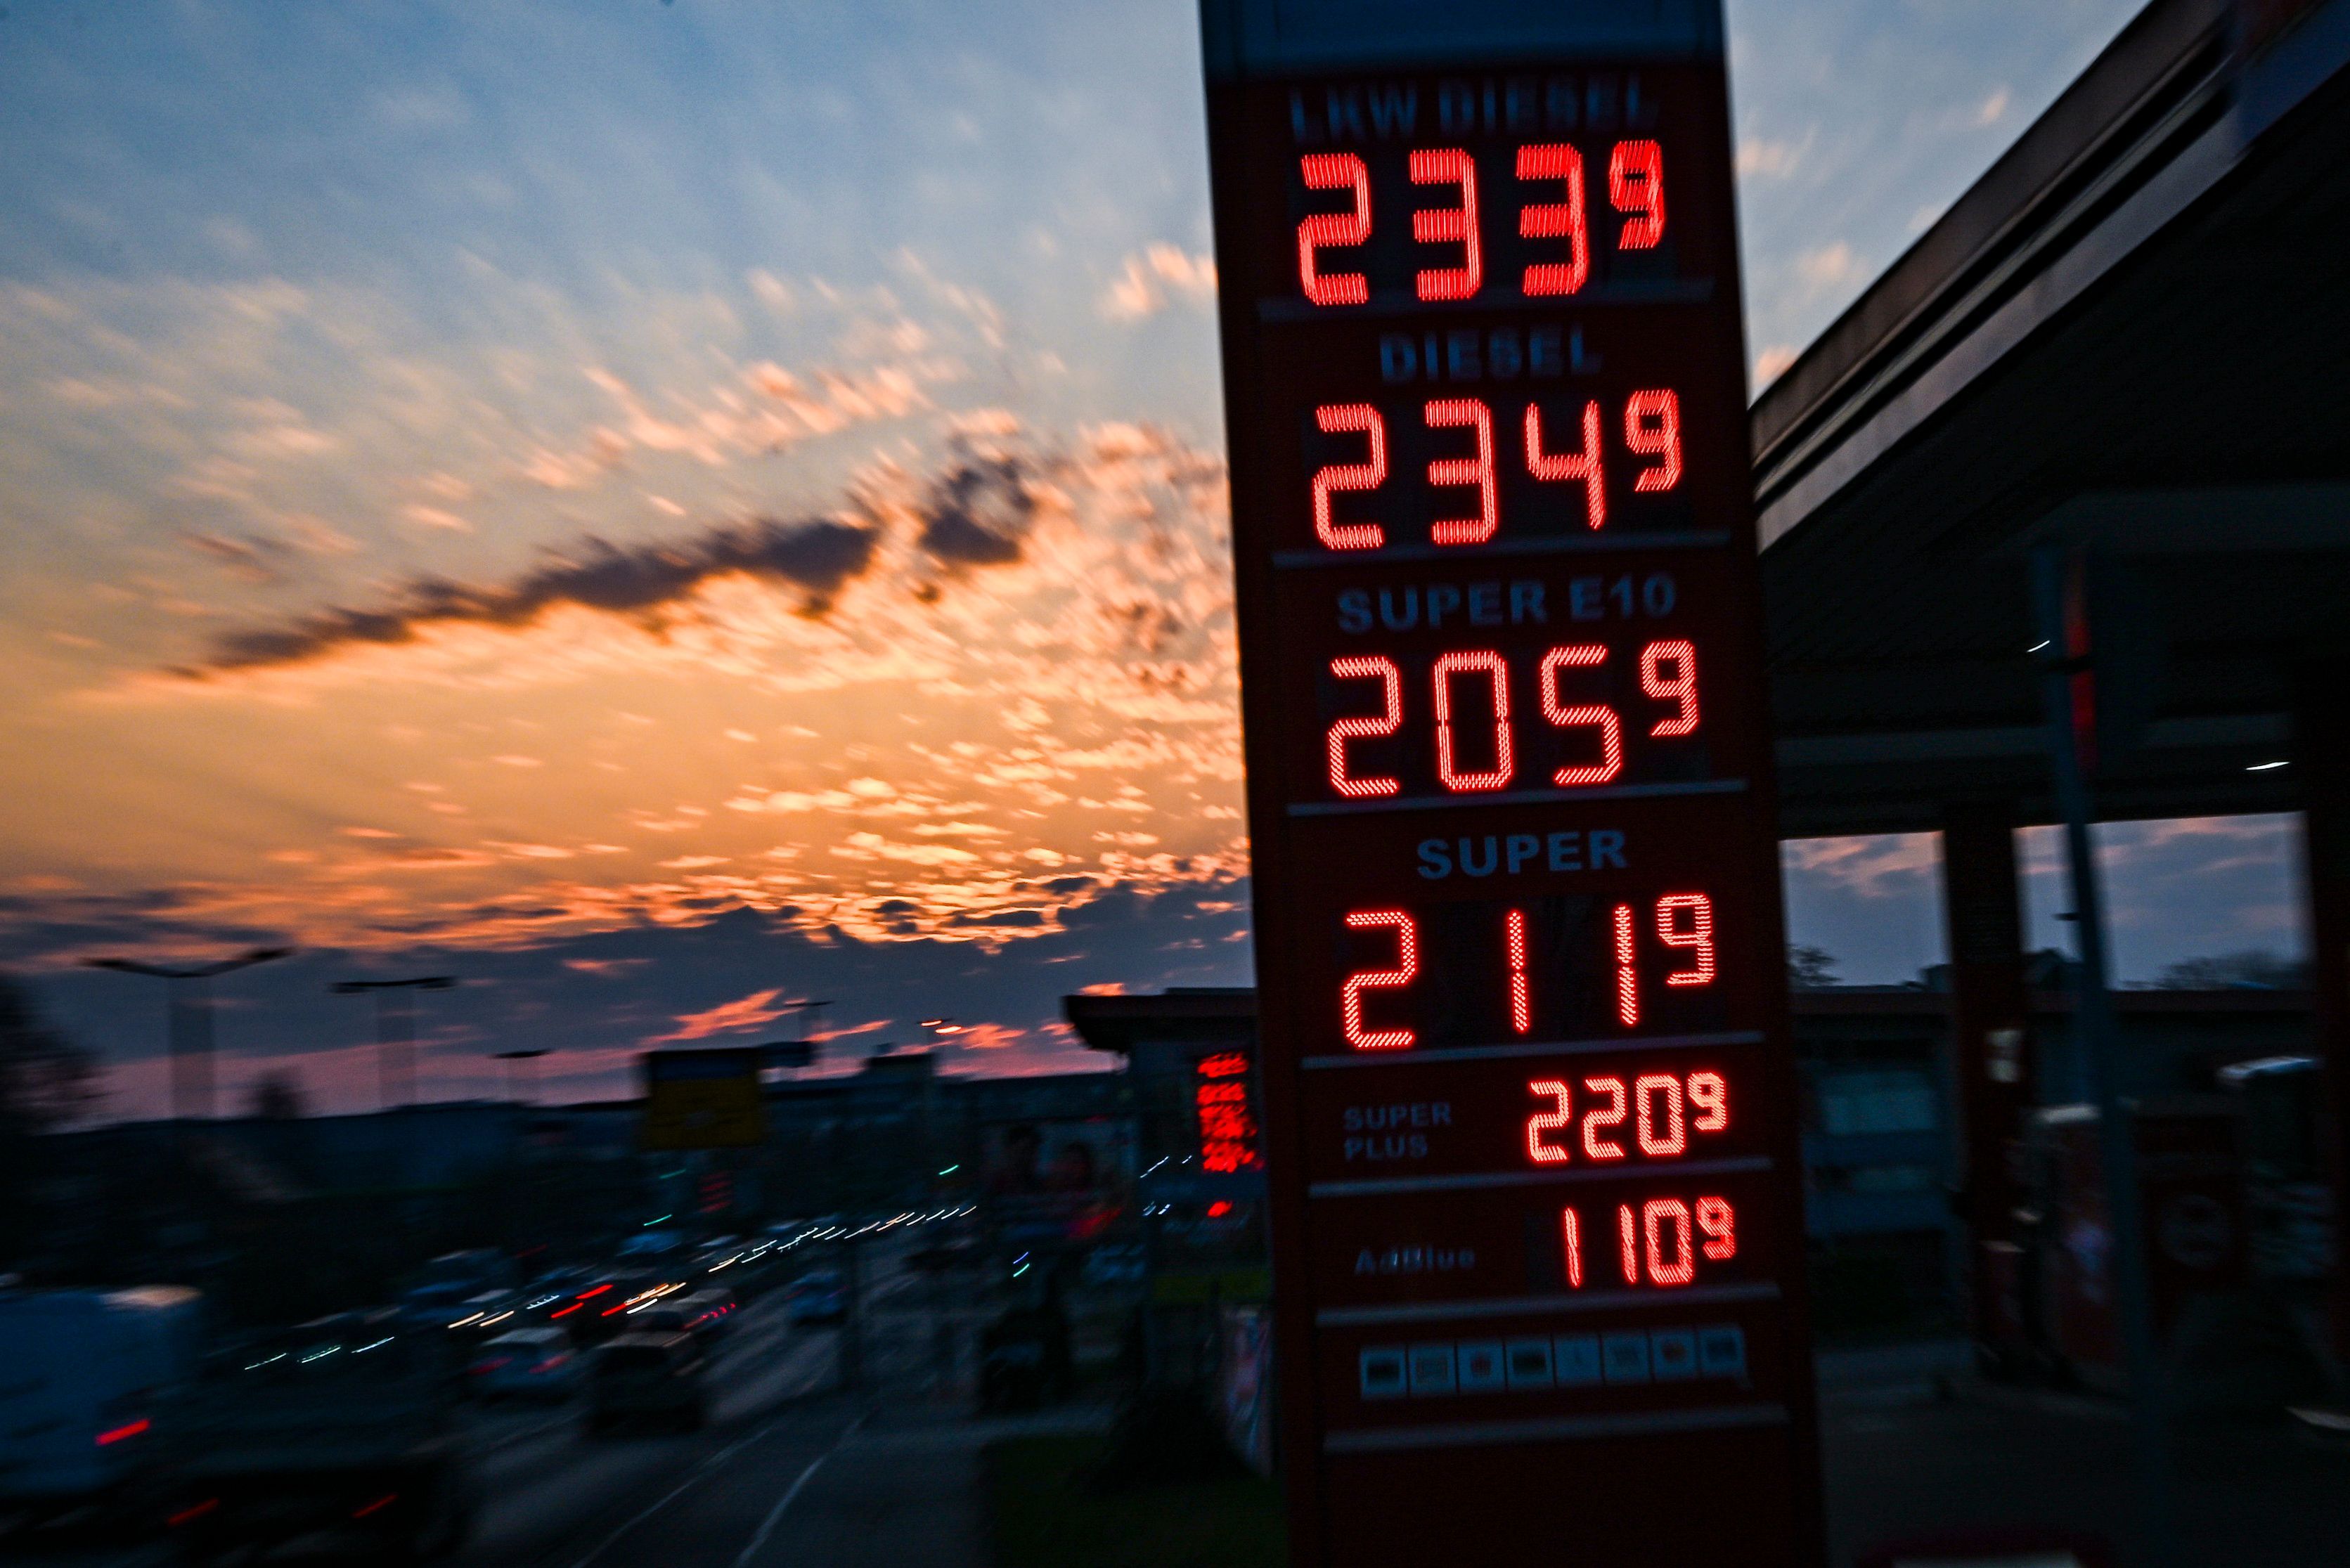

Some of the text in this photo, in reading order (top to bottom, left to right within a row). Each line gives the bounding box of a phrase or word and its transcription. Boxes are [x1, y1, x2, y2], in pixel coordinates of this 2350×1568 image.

[1289, 74, 1659, 141] LKW DIESEL
[1297, 139, 1668, 306] 2339
[1379, 323, 1603, 385] DIESEL
[1312, 387, 1684, 550] 2349
[1336, 571, 1678, 633] SUPER E10
[1328, 639, 1700, 798] 2059
[1416, 829, 1629, 880] SUPER
[1342, 1101, 1454, 1132] SUPER
[1343, 1133, 1428, 1163] PLUS
[1525, 1071, 1728, 1163] 2209
[1355, 1244, 1476, 1276] AdBlue
[1562, 1195, 1738, 1288] 1109
